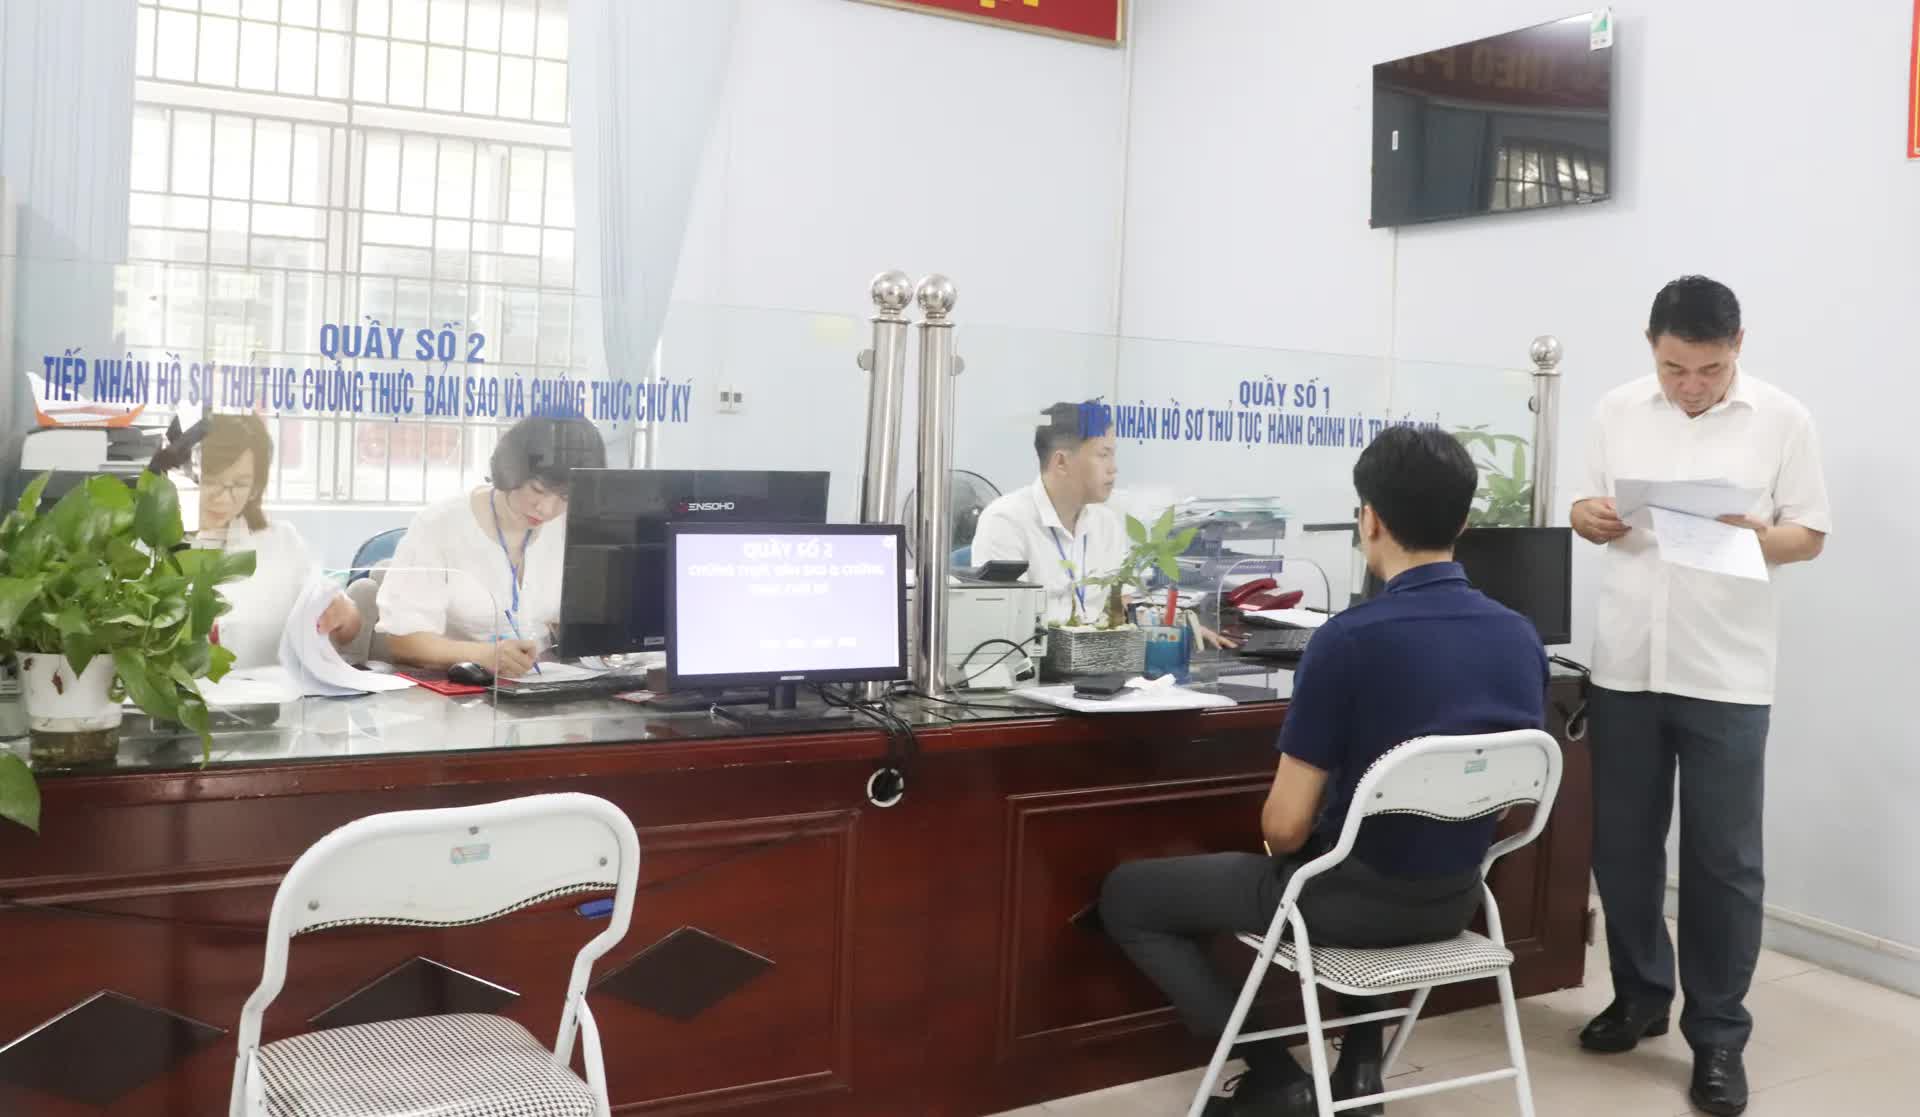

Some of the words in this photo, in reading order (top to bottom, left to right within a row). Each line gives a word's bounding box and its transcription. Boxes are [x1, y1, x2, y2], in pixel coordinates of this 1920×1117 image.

[320, 315, 404, 361] QUẦY
[416, 321, 461, 362] SỐ
[467, 333, 485, 364] 2
[43, 347, 87, 402] TIẾP
[93, 351, 149, 414] NHẬN
[156, 351, 182, 405] HỒ
[189, 361, 216, 408] SƠ
[222, 351, 256, 408] THỦ
[260, 367, 297, 419] TỤC
[369, 368, 414, 423] THỰC
[424, 362, 460, 417] BẢN
[465, 376, 499, 418] SAO
[504, 371, 525, 418] VÀ
[531, 371, 586, 419] CHỨNG
[591, 377, 632, 430] THỰC
[636, 376, 669, 423] CHỮ
[671, 376, 694, 424] KÝ
[1239, 374, 1287, 408] QUẦY
[1293, 376, 1319, 408] SỐ
[1322, 386, 1330, 410] 1
[1115, 399, 1157, 446] NHẬN
[1161, 397, 1181, 441] HỒ
[1184, 407, 1205, 441] SƠ
[1207, 399, 1233, 442] THỦ
[1237, 411, 1262, 450] TỤC
[1267, 407, 1303, 445] HÀNH
[1307, 409, 1345, 448] CHÍNH
[1349, 411, 1364, 449] VÀ
